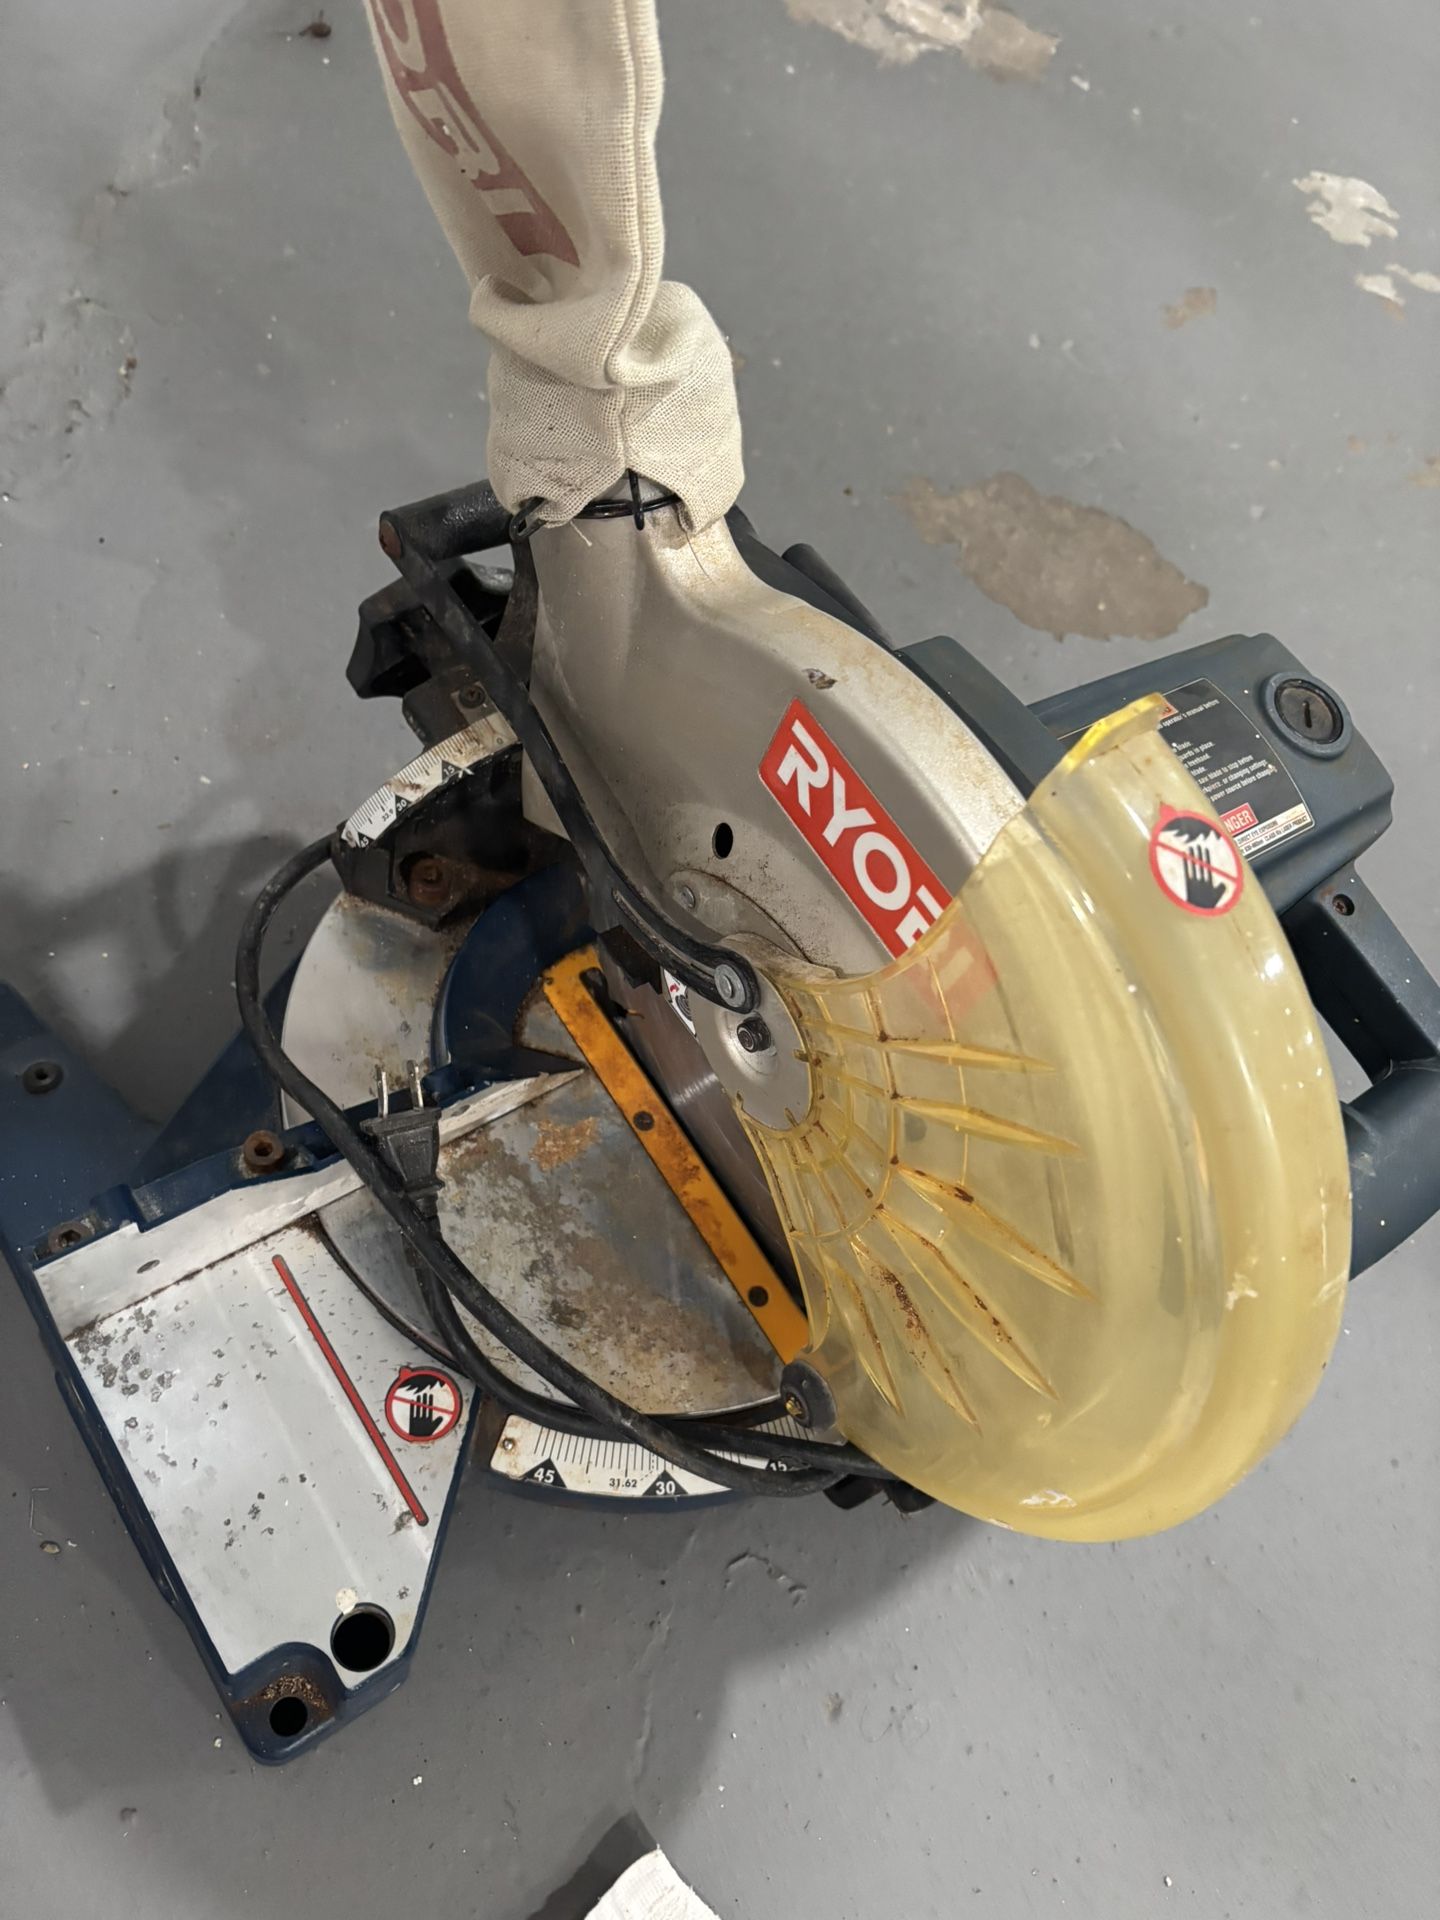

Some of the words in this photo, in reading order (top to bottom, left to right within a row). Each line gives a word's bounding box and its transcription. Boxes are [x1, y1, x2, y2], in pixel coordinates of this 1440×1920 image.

[444, 765, 455, 775] 15
[396, 800, 408, 811] 30
[1223, 810, 1253, 833] NGER
[360, 837, 369, 848] 45
[533, 1467, 555, 1483] 45
[608, 1477, 638, 1488] 31.62
[655, 1480, 676, 1496] 30
